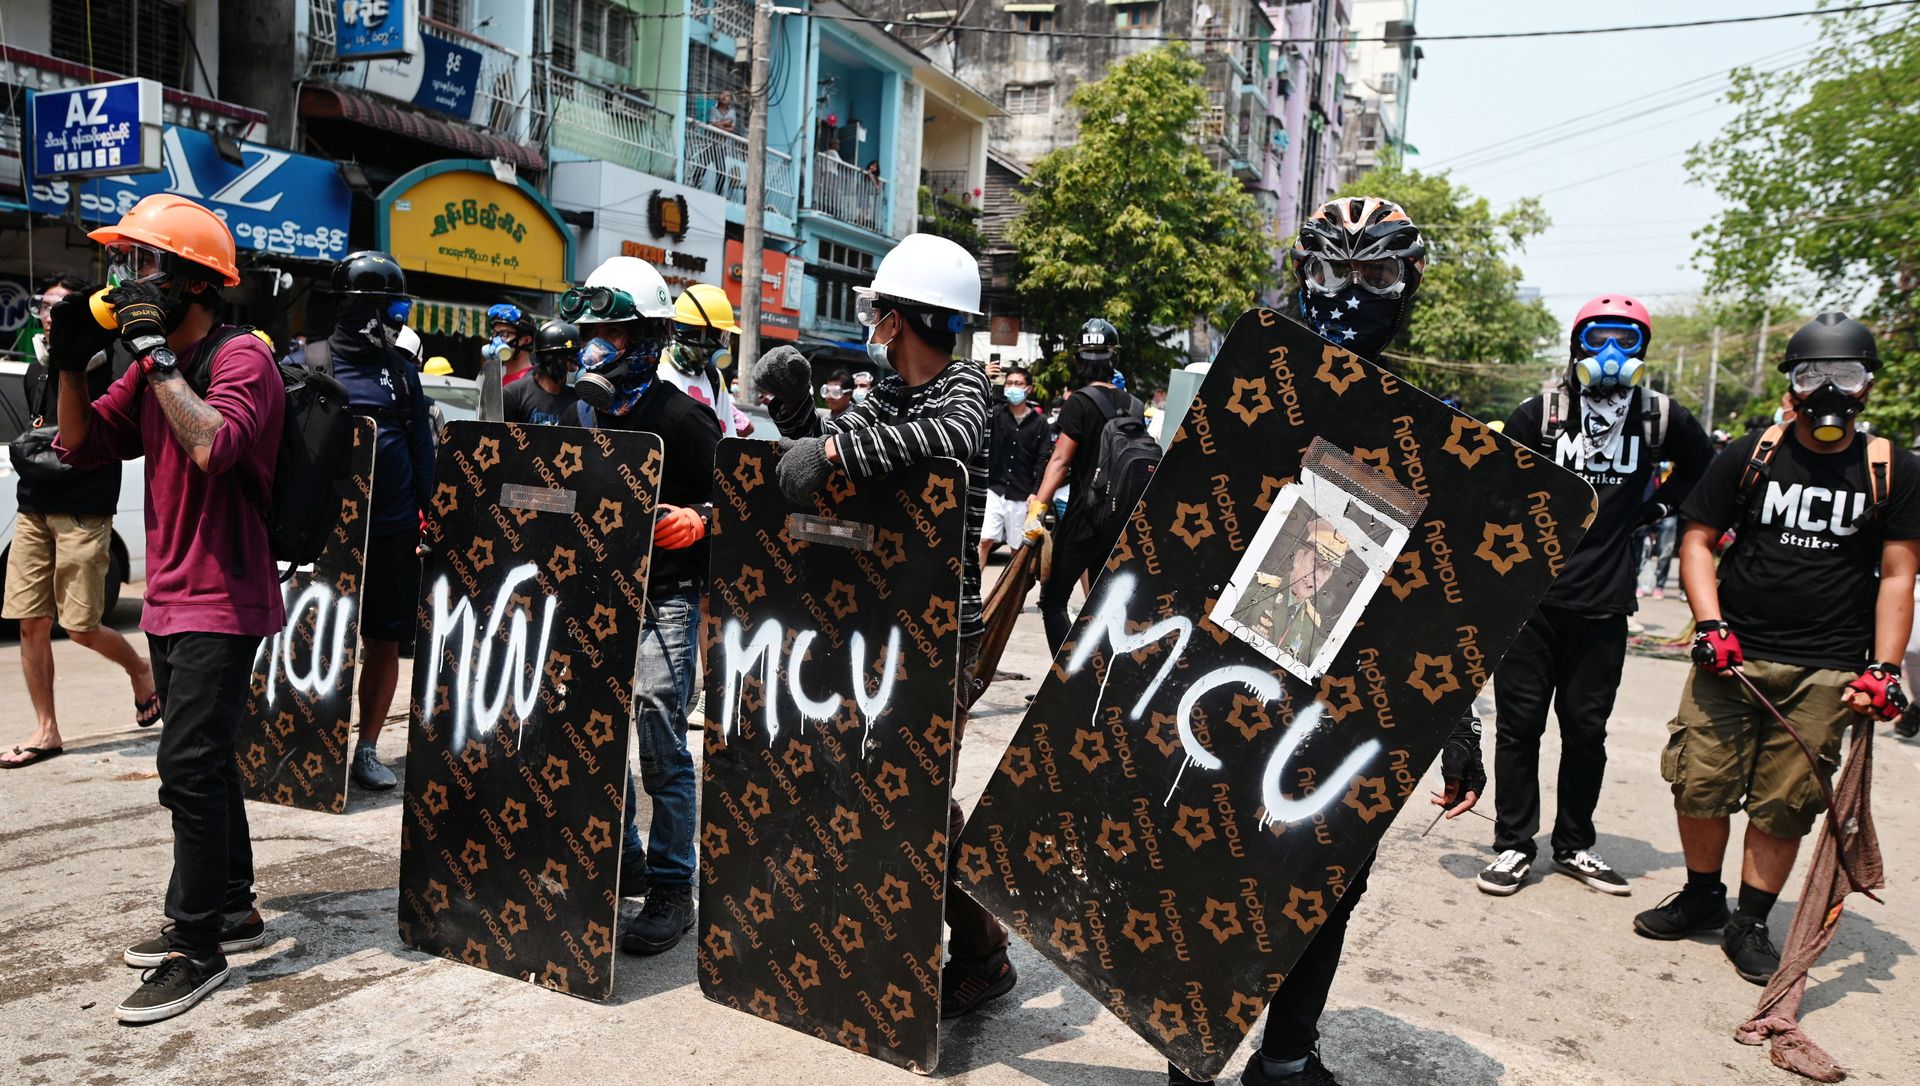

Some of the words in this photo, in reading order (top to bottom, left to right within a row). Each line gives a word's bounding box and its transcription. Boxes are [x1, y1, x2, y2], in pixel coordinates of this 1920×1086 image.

[65, 88, 108, 128] AZ
[1269, 346, 1304, 427] makply
[453, 450, 487, 498] makply
[1392, 415, 1430, 499] makply
[617, 463, 656, 514] makply
[713, 467, 751, 522] makply
[1211, 474, 1244, 552] makply
[1761, 480, 1866, 536] MCU
[488, 503, 524, 552] makply
[571, 511, 608, 562] makply
[896, 489, 942, 548] makply
[1528, 490, 1565, 578] makply
[1780, 532, 1839, 549] Striker
[447, 549, 481, 598] makply
[756, 529, 797, 585] makply
[850, 549, 892, 600] makply
[1424, 520, 1463, 604] makply
[715, 577, 754, 632] makply
[801, 592, 844, 649] makply
[566, 617, 603, 668] makply
[898, 608, 943, 669] makply
[1456, 624, 1485, 696] akply
[289, 687, 316, 724] makply
[723, 618, 900, 742] MCU
[1067, 573, 1382, 824] MCU
[1359, 648, 1395, 729] makply
[260, 719, 286, 756] makply
[317, 727, 344, 765] makply
[562, 721, 600, 775] makply
[814, 719, 846, 763] akply
[899, 727, 945, 786] makply
[1032, 723, 1063, 793] makply
[1106, 706, 1138, 779] makply
[288, 760, 314, 797] makply
[441, 750, 477, 800] makply
[519, 766, 557, 818] makply
[760, 750, 800, 805] makply
[851, 771, 895, 831] makply
[405, 791, 437, 841] makply
[479, 808, 516, 860] makply
[719, 791, 758, 846] makply
[806, 815, 848, 872] makply
[1132, 797, 1164, 870] makply
[1212, 783, 1245, 858] makply
[440, 849, 477, 900] makply
[560, 826, 599, 880] makply
[900, 840, 944, 901] makply
[989, 824, 1020, 895] makply
[519, 868, 557, 921] makply
[763, 855, 804, 911] makply
[404, 888, 439, 937] makply
[479, 908, 516, 961] makply
[723, 895, 763, 949] makply
[853, 882, 897, 941] makply
[1084, 900, 1114, 970] makply
[1159, 889, 1191, 962] makply
[1239, 877, 1273, 954] makply
[560, 930, 599, 984] makply
[809, 922, 852, 979] makply
[768, 959, 808, 1016] makply
[857, 990, 901, 1048] makply
[1185, 981, 1216, 1054] makply
